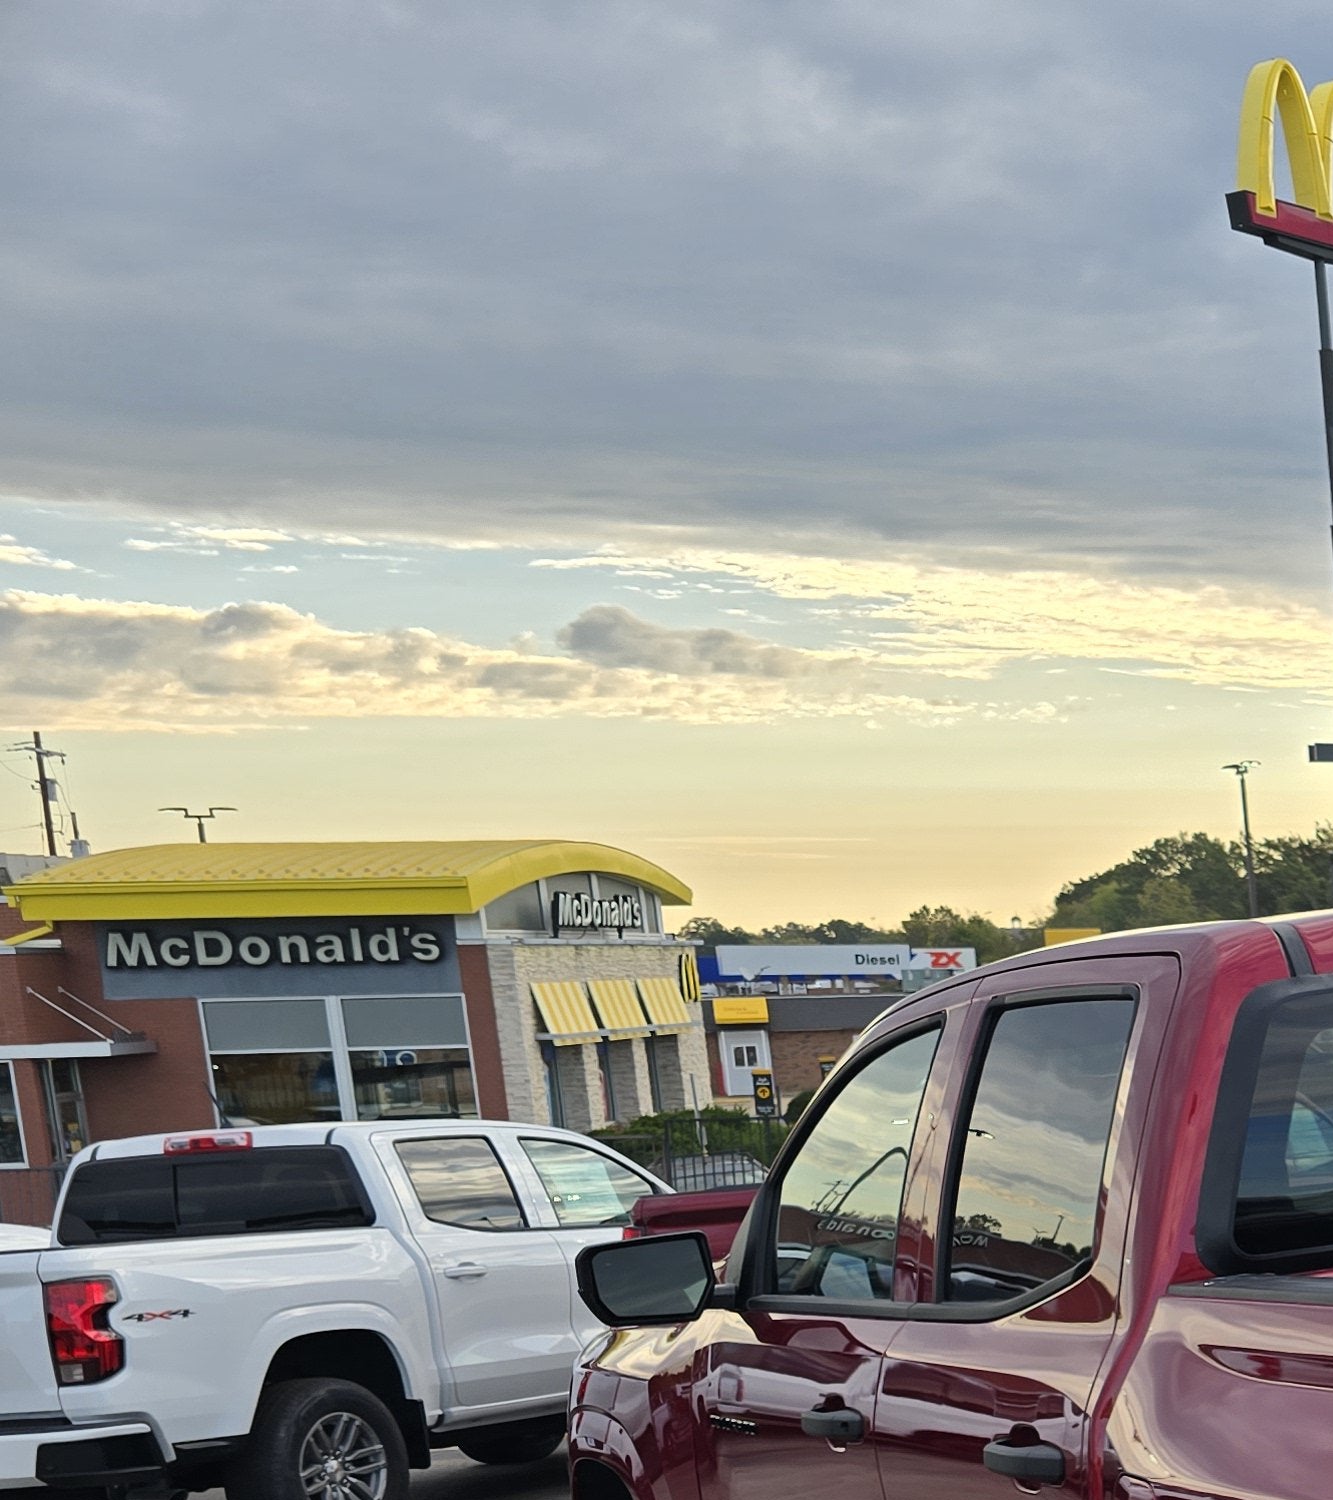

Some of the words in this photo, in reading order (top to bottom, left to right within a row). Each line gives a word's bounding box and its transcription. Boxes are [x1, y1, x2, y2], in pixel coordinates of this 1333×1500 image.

[556, 891, 642, 929] McDonald's
[105, 926, 441, 968] McDonald's
[855, 953, 900, 966] Diesel
